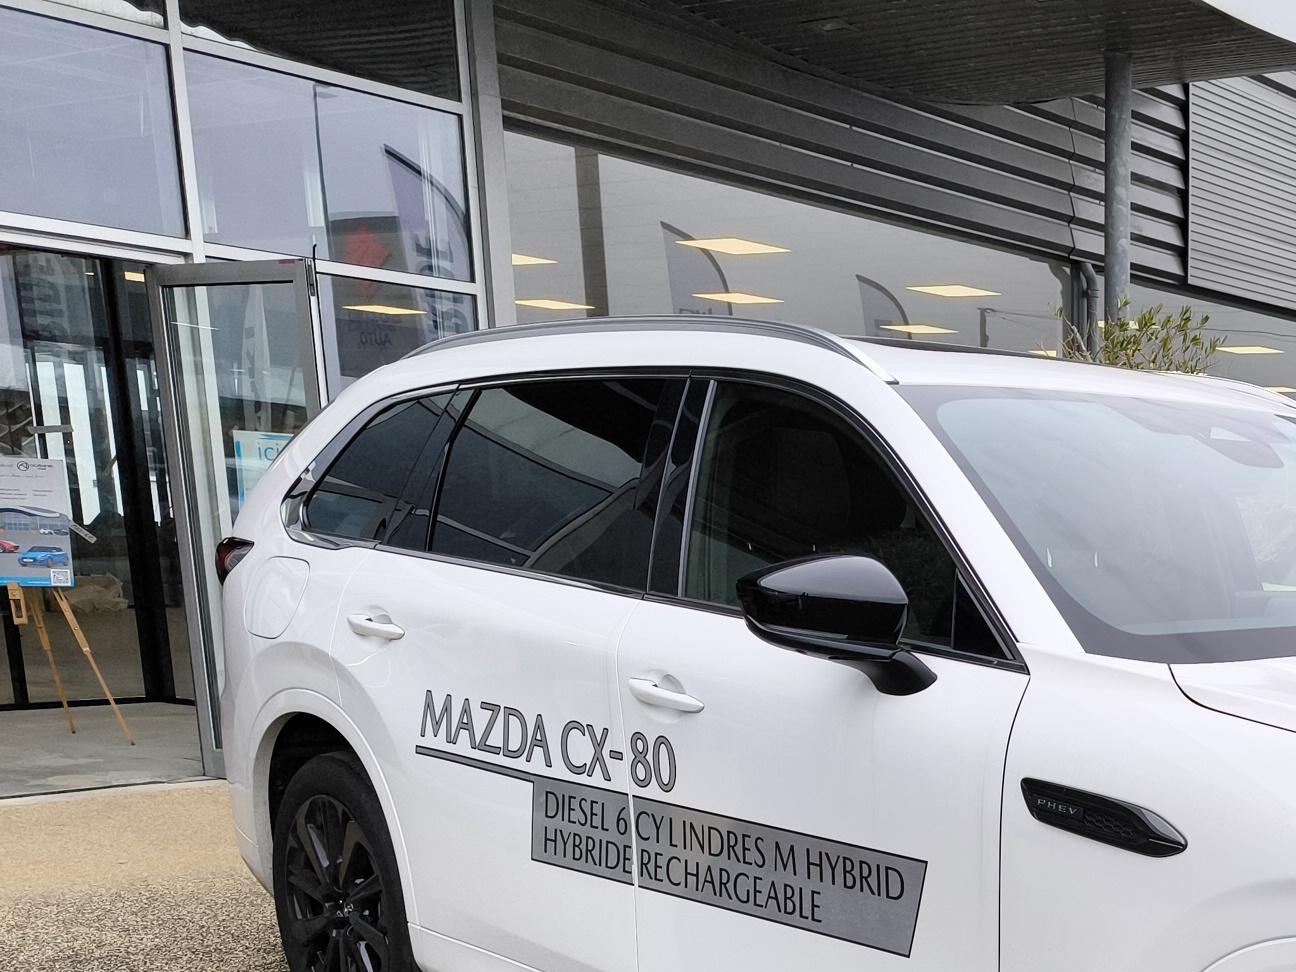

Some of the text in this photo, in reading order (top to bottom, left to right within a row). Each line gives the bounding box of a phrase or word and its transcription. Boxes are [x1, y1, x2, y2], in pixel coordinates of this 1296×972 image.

[420, 689, 677, 792] MAZDA CX-80
[543, 789, 906, 901] DIESEL 6 CYLINDRES M HYBRID
[1036, 798, 1079, 816] PHEV
[543, 827, 823, 924] HYBRIDE RECHARGEABLE
